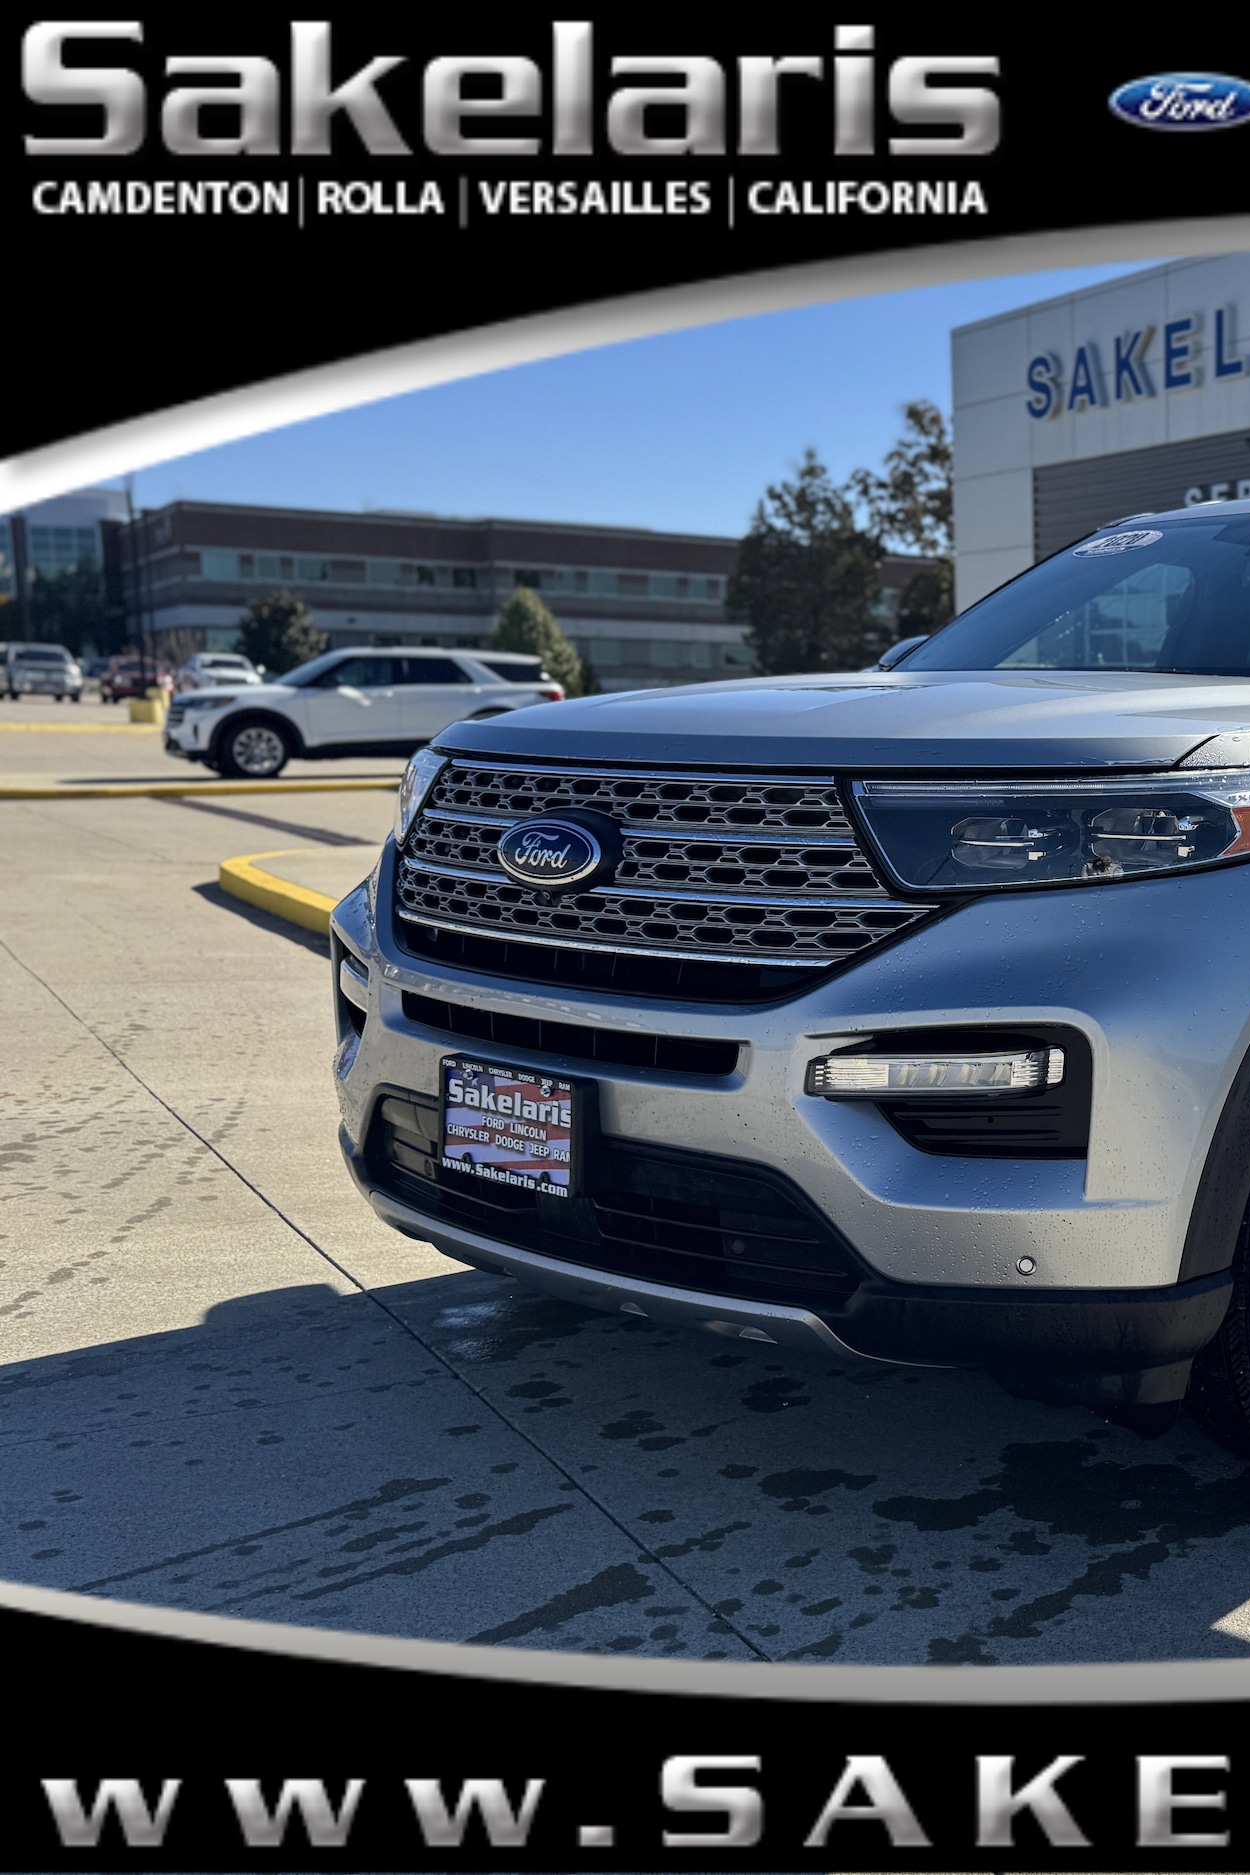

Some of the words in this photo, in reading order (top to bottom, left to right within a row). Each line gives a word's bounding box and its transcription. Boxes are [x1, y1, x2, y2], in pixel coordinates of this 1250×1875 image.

[514, 831, 572, 869] Ford
[442, 1059, 457, 1068] FORD
[462, 1062, 484, 1073] LINCOLN
[488, 1067, 513, 1079] CHRYSLER
[518, 1073, 536, 1084] DODGE
[558, 1082, 571, 1092] RAM
[448, 1077, 572, 1129] Sakelaris
[446, 1123, 490, 1143] CHRYSLER
[495, 1134, 525, 1151] DODGE
[529, 1142, 550, 1157] JEEP
[481, 1115, 505, 1131] FORD
[510, 1122, 547, 1141] LINCOLN
[441, 1156, 569, 1198] www.Sakelaris.com
